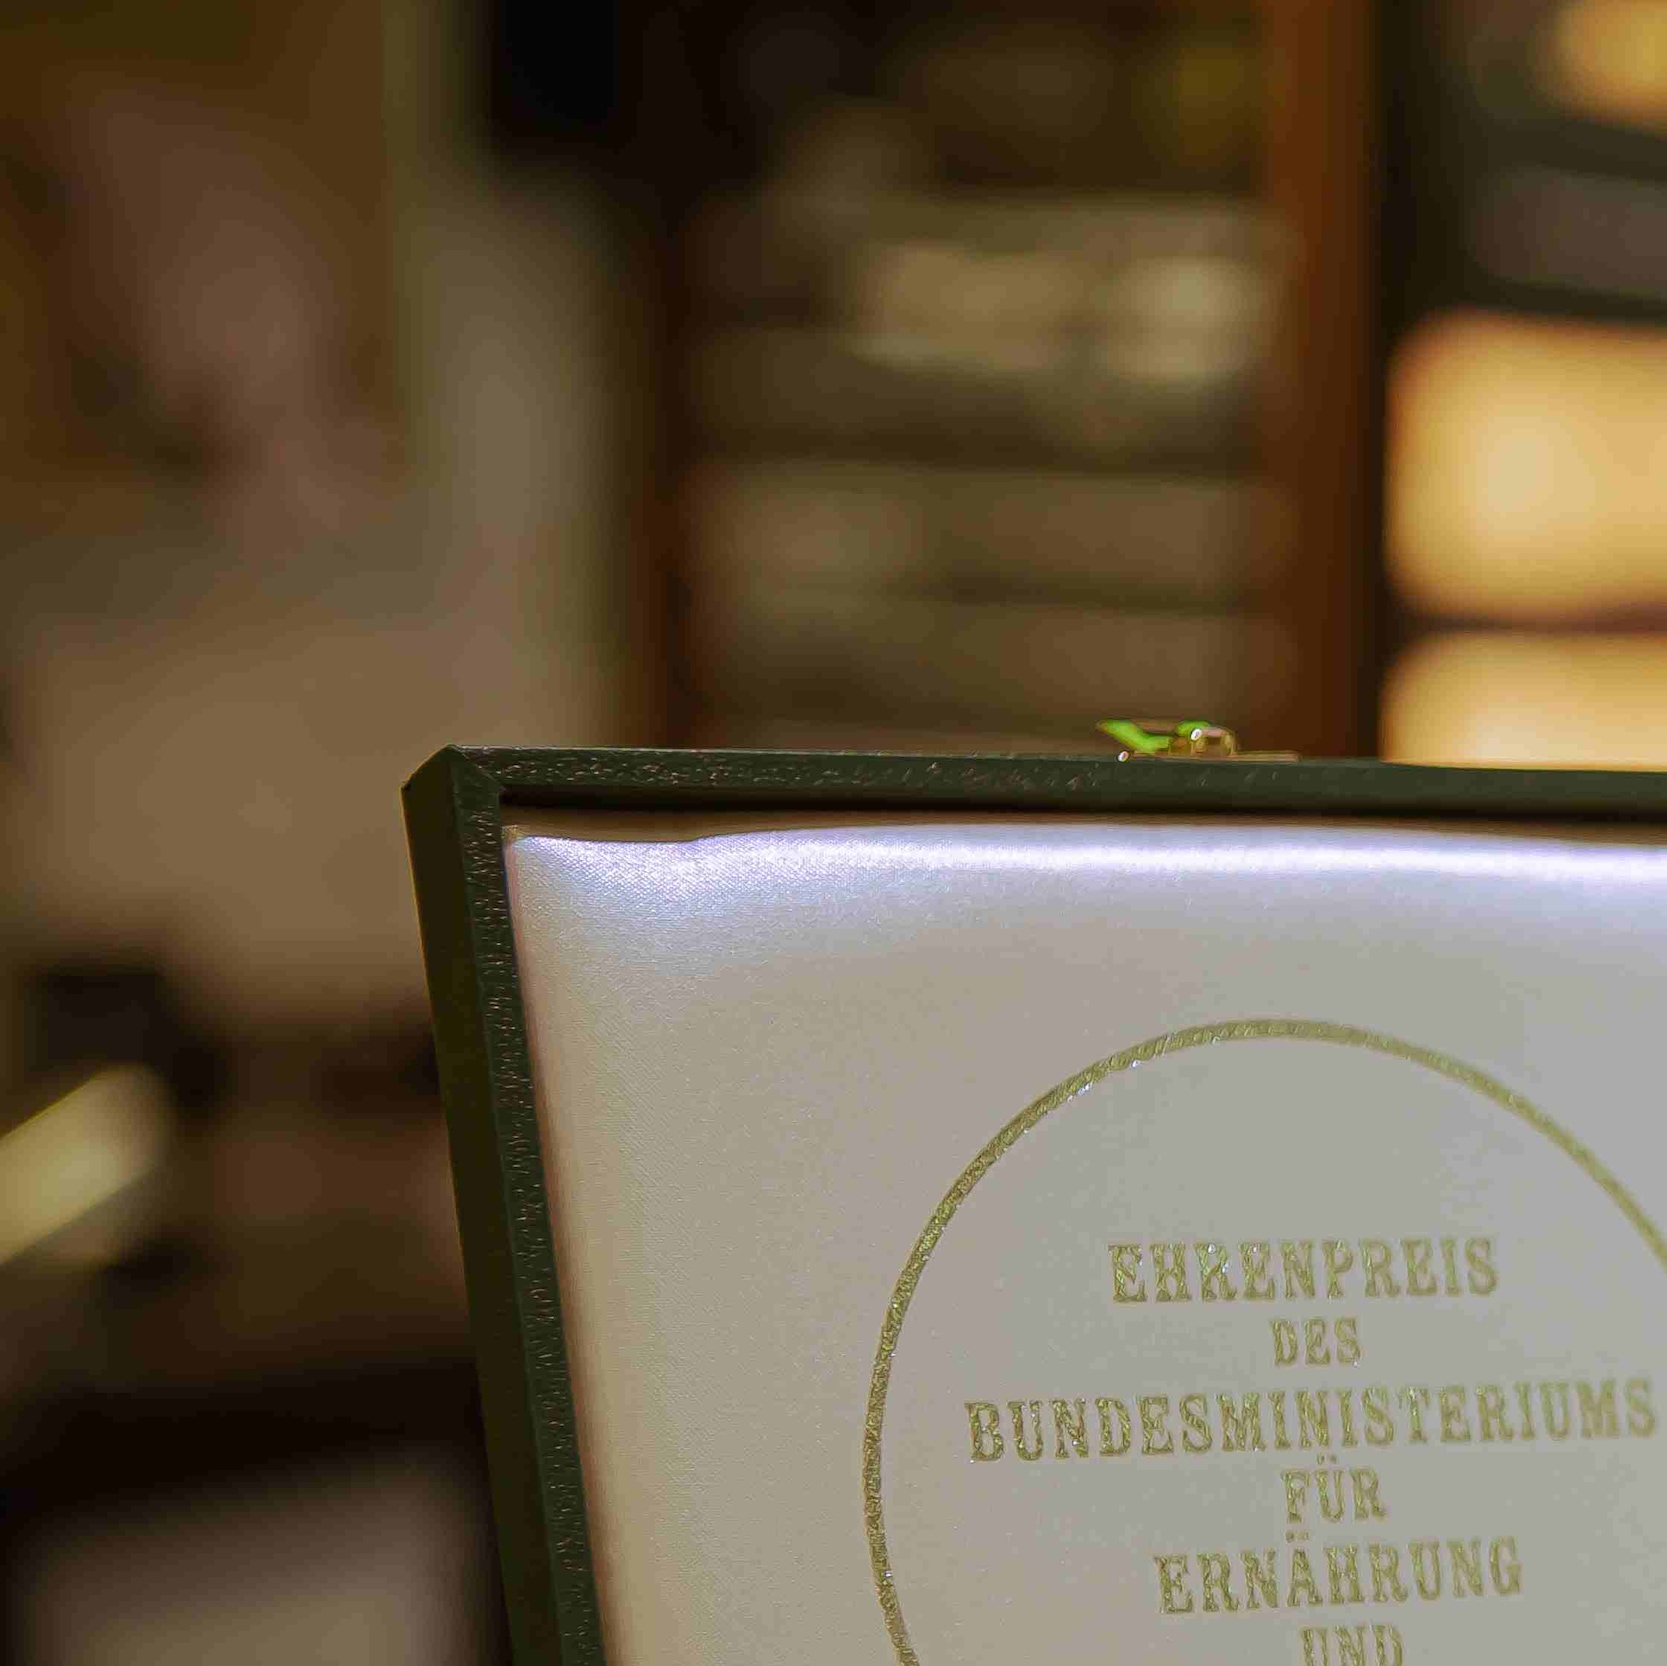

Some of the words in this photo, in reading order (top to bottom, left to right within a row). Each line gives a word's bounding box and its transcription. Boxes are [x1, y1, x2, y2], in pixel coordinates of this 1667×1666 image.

[1108, 1237, 1499, 1304] EHRENPREIS
[1270, 1317, 1362, 1367] DES
[964, 1378, 1658, 1463] BUNDESMINISTERIUMS
[1280, 1454, 1388, 1524] FÜR
[1153, 1532, 1523, 1615] ERNÄHRUNG
